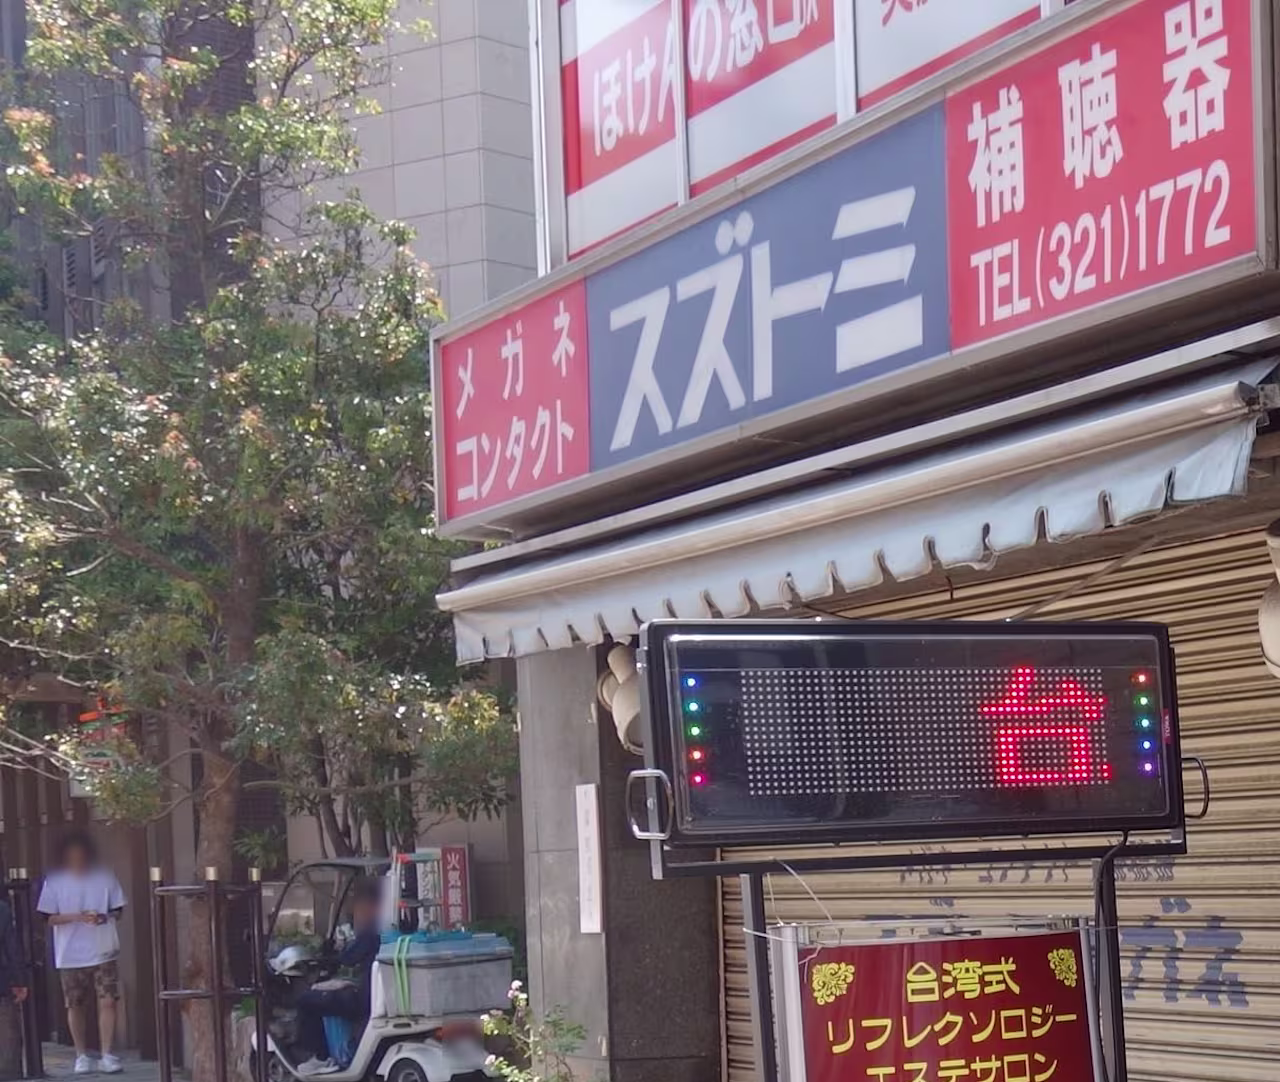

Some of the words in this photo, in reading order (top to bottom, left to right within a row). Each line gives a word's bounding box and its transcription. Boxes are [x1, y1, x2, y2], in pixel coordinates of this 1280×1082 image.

[966, 0, 1232, 228] 補聴器
[969, 159, 1232, 327] TEL(321)1772
[456, 300, 576, 420] メガネ
[610, 185, 924, 453] スズトミ
[456, 399, 575, 501] コンタクト
[979, 666, 1102, 782] 台
[826, 1004, 1078, 1054] リフレクソロジー
[906, 955, 1021, 1003] 台湾式
